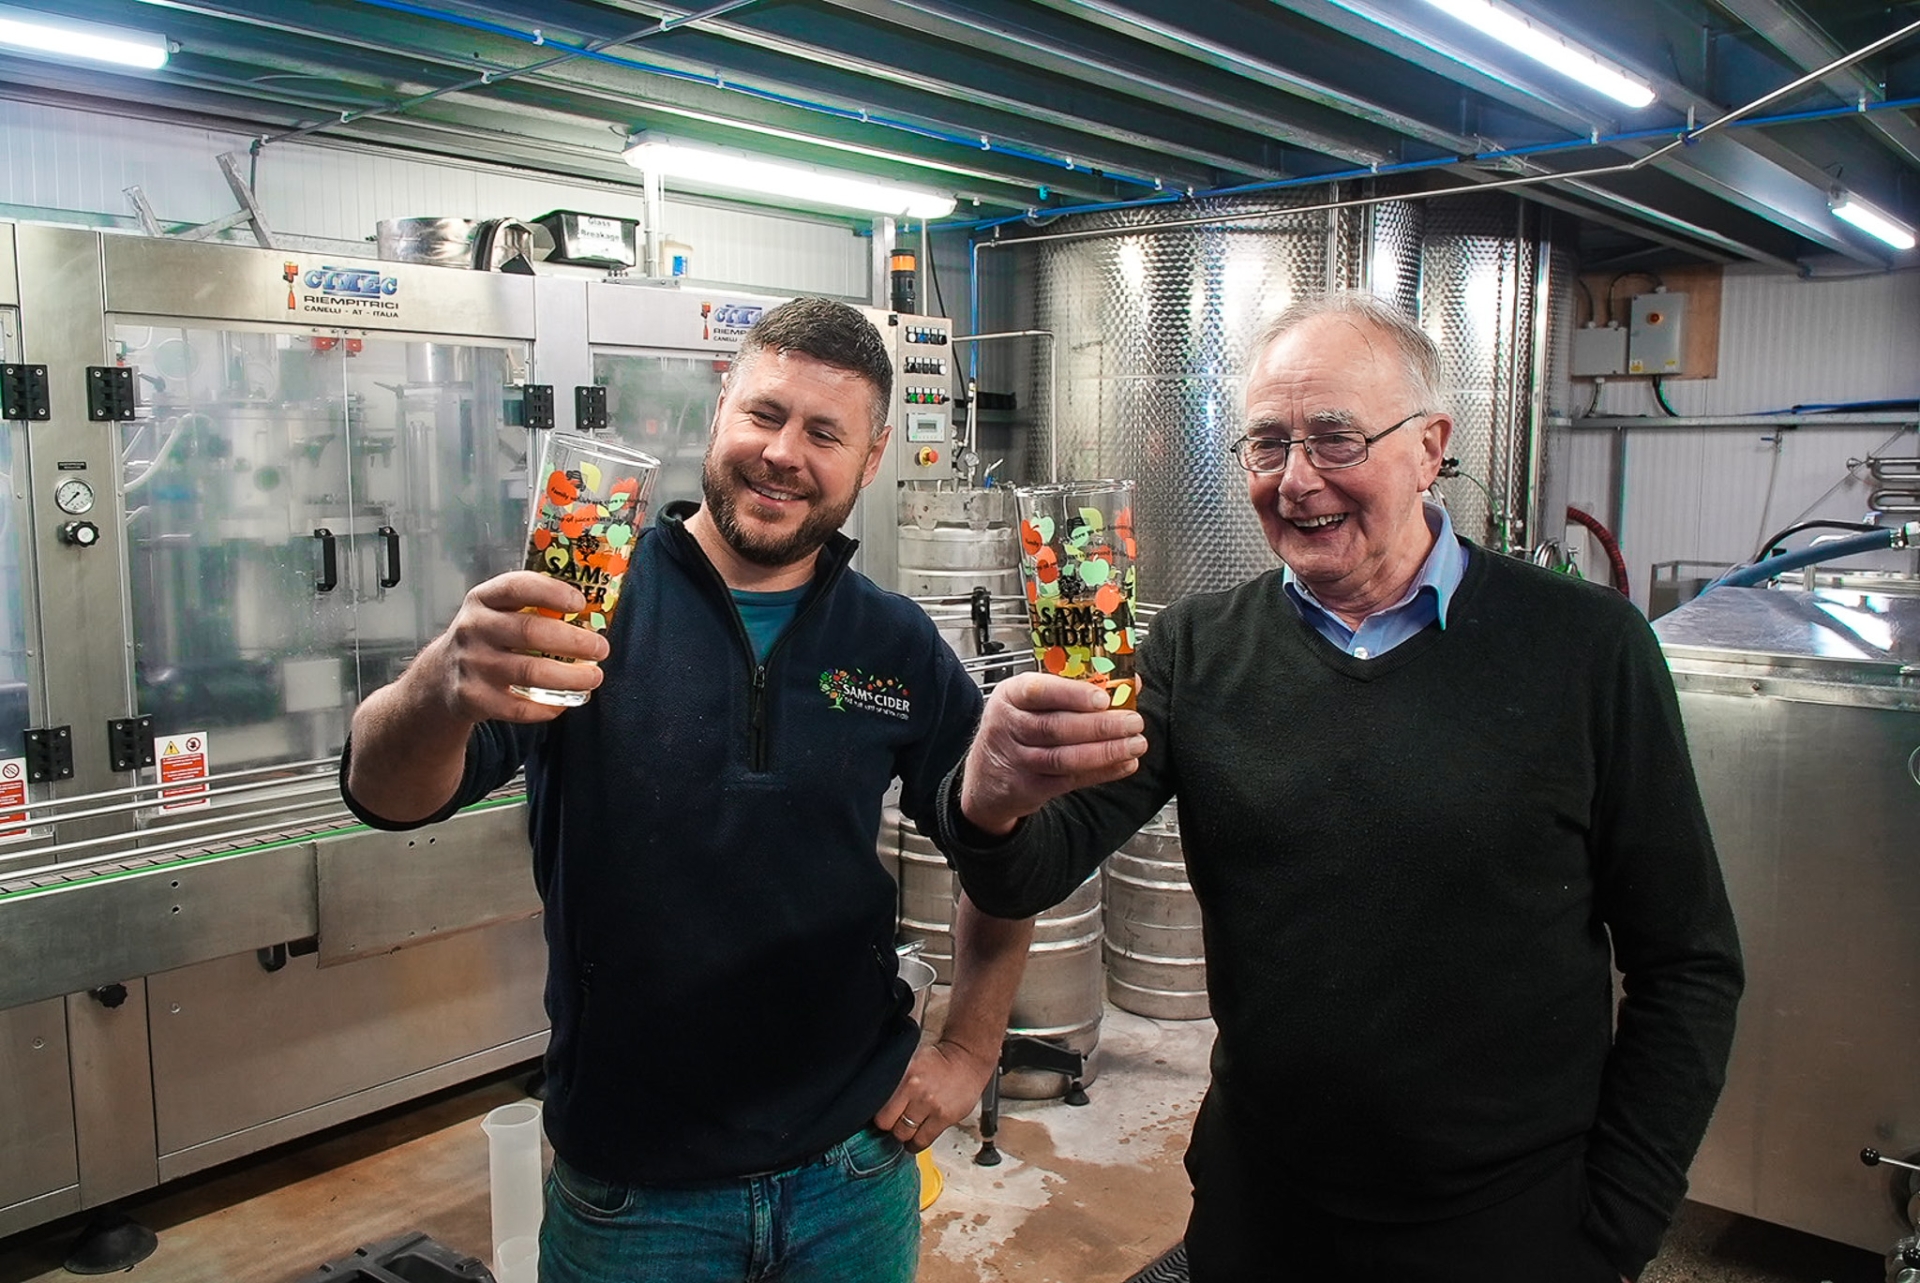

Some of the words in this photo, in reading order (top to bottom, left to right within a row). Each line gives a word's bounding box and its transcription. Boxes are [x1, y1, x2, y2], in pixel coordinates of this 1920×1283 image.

[588, 218, 611, 227] Glass
[581, 229, 620, 242] Breakage
[304, 269, 398, 296] CIMEC
[303, 295, 399, 310] RIEMPITRICI
[304, 305, 342, 315] CANELLI
[373, 310, 399, 319] ITALIA
[1041, 626, 1107, 647] CIDER
[874, 694, 910, 712] CIDER
